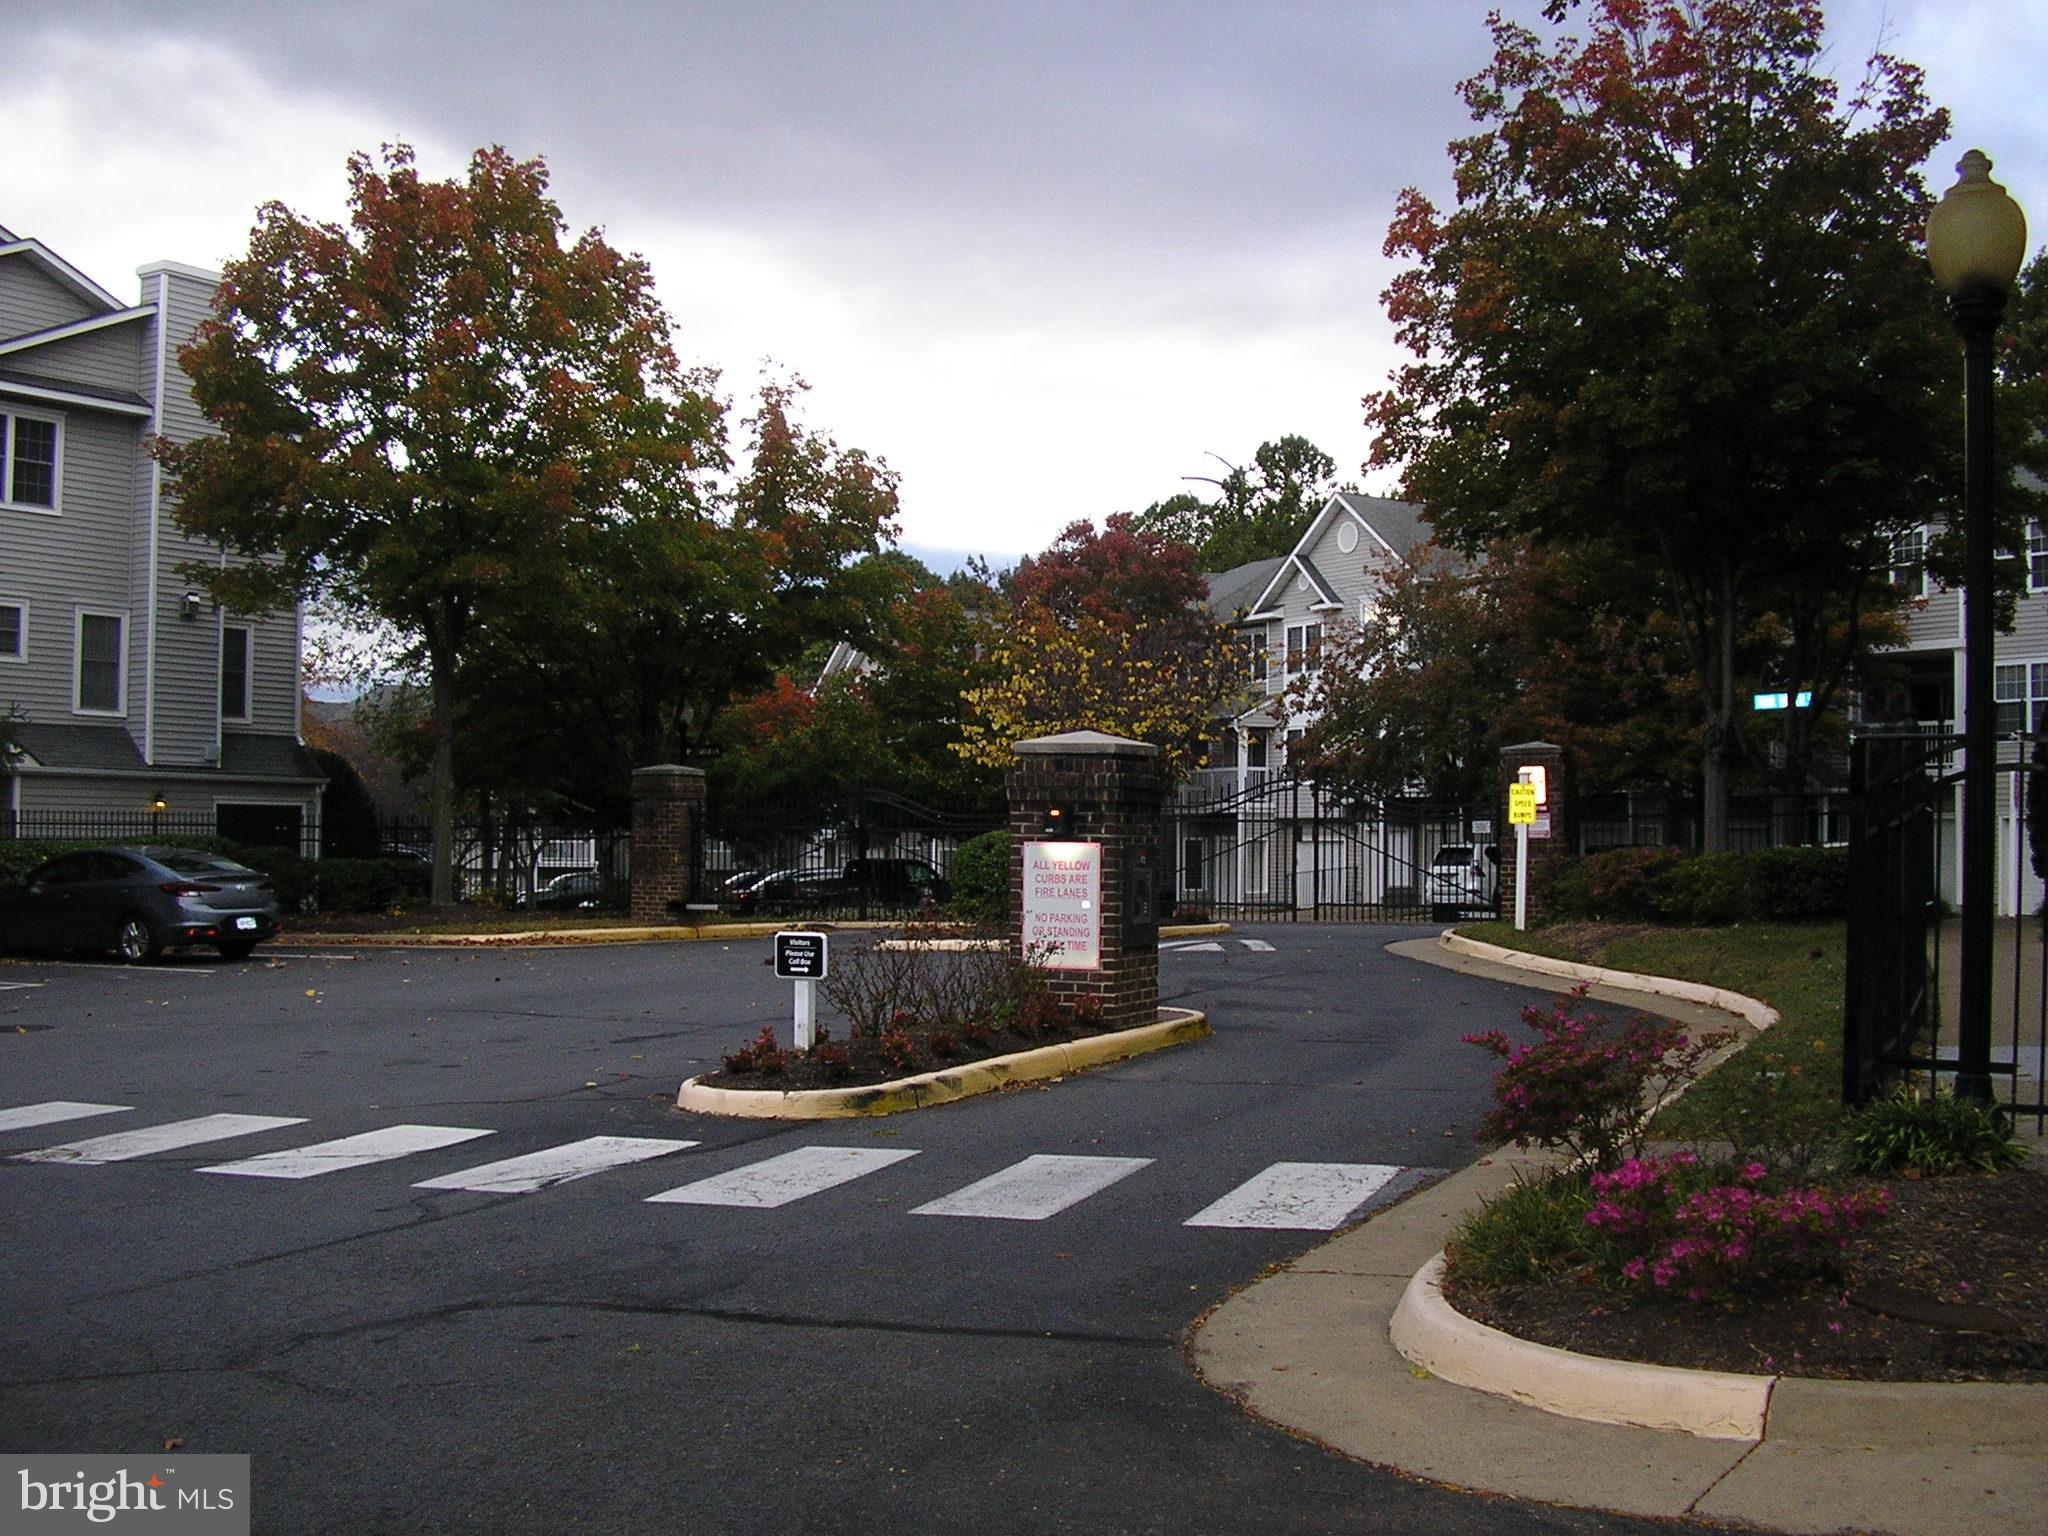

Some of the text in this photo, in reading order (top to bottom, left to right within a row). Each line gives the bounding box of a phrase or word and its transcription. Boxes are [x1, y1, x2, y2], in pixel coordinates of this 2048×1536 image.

[1033, 861, 1091, 871] ALL YELLOW
[1035, 874, 1088, 884] CURBS ARE
[1035, 887, 1088, 898] FIRE LANES
[1035, 912, 1088, 924] NO PARKING
[1032, 927, 1090, 938] OR STANDING
[1067, 941, 1087, 951] TIME
